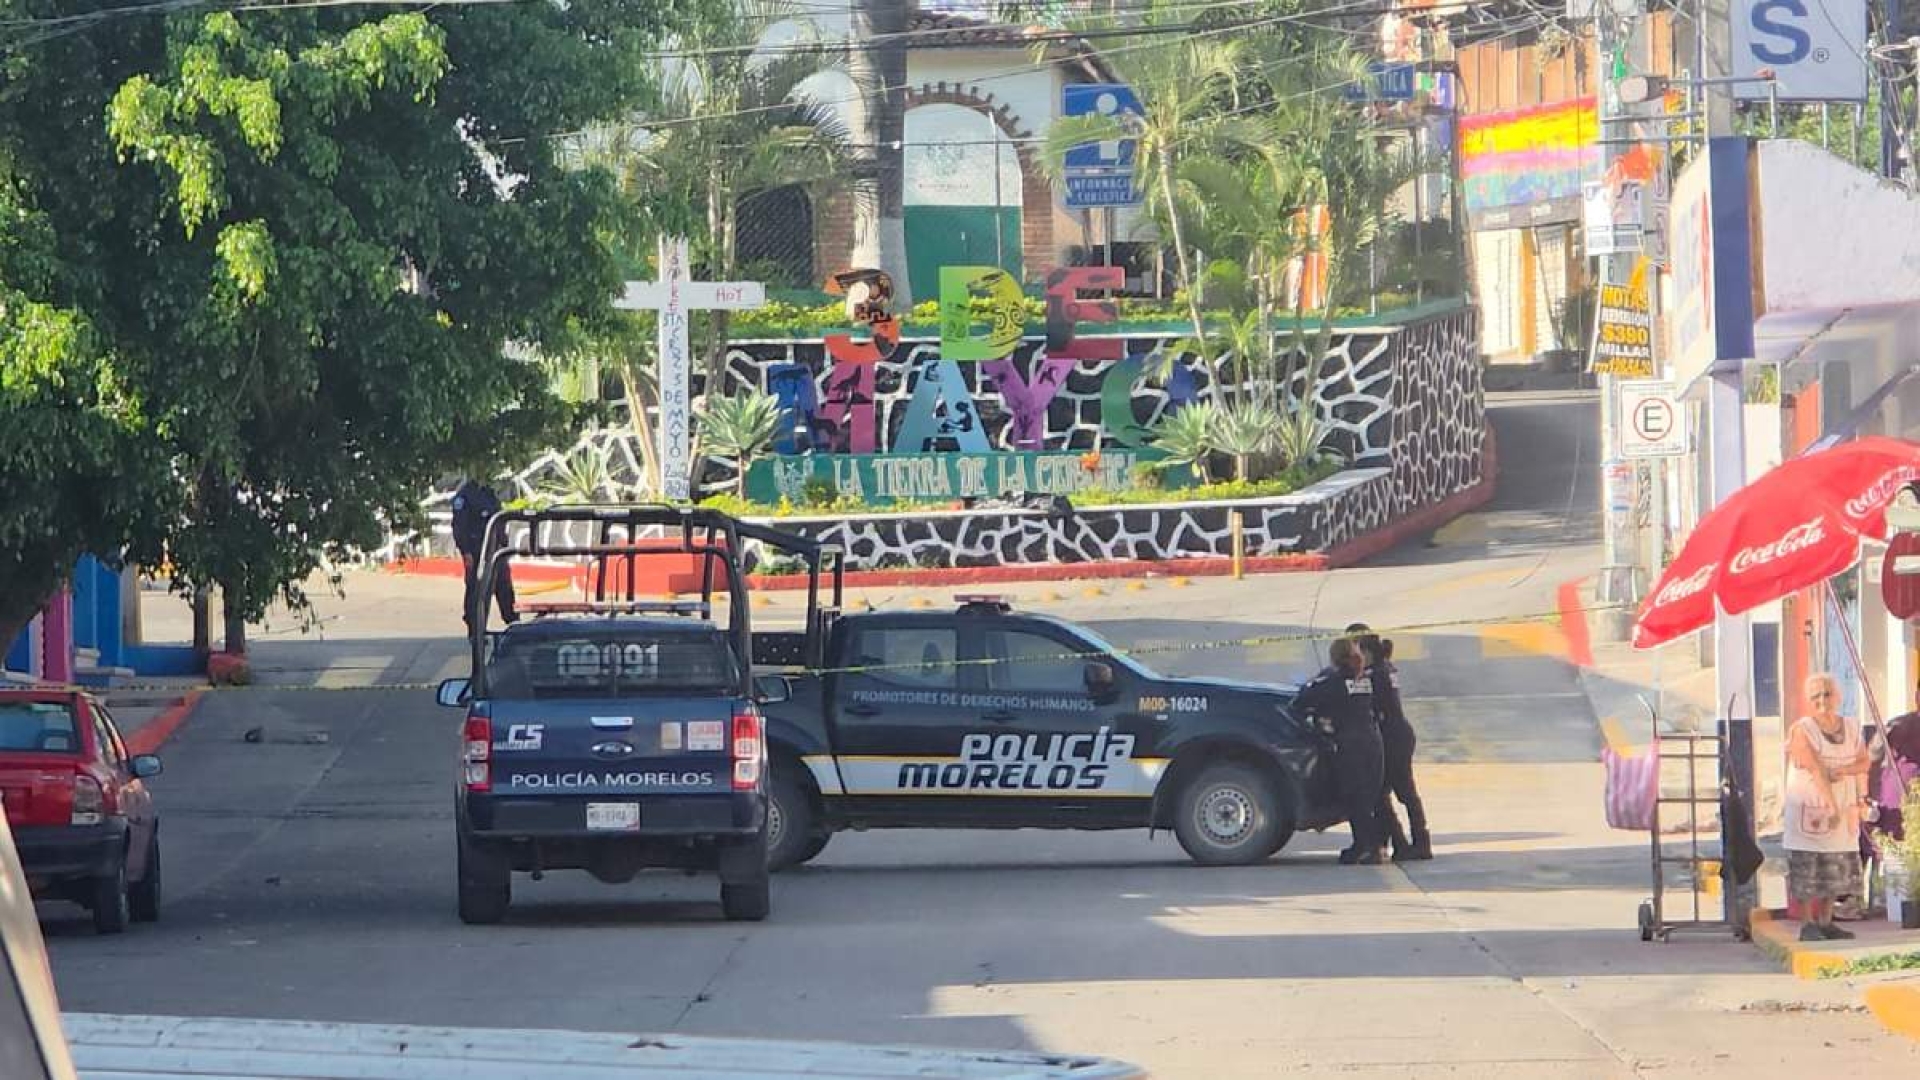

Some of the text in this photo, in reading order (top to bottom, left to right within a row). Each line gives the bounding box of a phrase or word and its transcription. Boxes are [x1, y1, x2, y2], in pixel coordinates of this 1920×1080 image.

[1751, 0, 1811, 65] S
[940, 265, 1126, 360] DE
[1642, 405, 1663, 433] E
[832, 458, 864, 496] LA
[871, 456, 951, 496] TIERRA
[956, 456, 988, 496] DE
[853, 690, 1096, 712] PROMOTORES DE DERECHOS HUMANOS
[511, 769, 713, 788] POLICÍA MORELOS
[898, 764, 1109, 791] MORELOS
